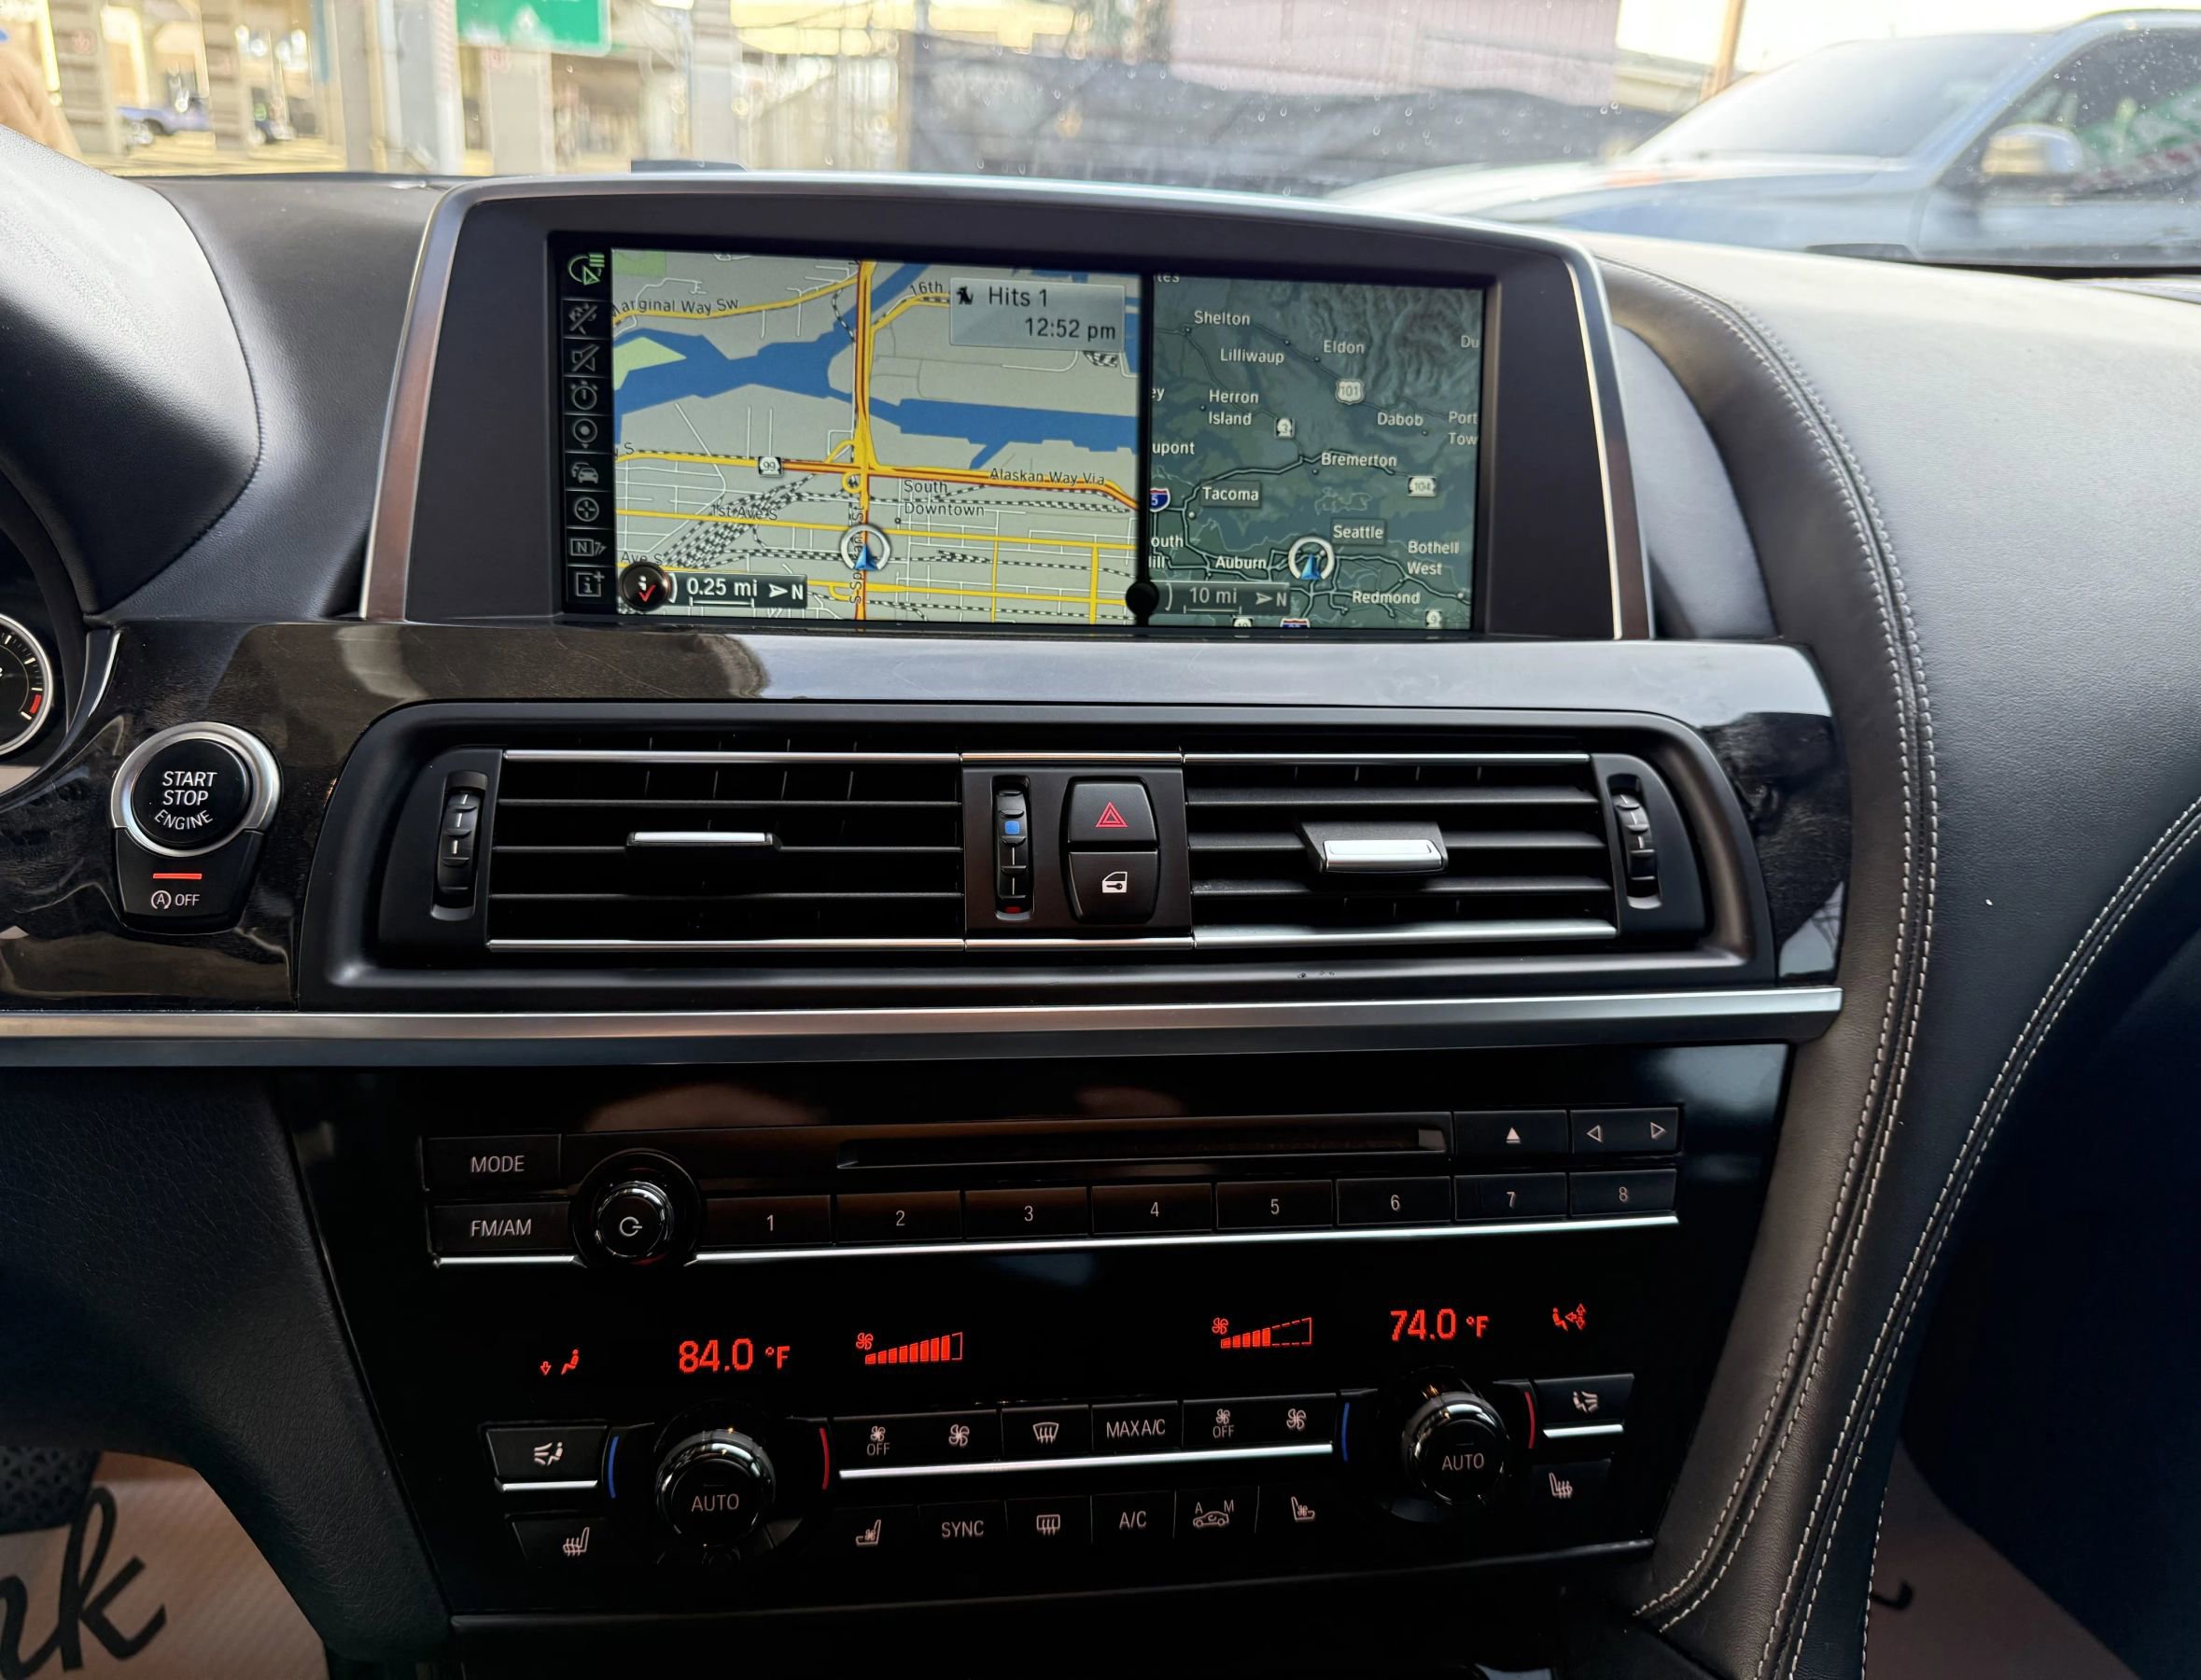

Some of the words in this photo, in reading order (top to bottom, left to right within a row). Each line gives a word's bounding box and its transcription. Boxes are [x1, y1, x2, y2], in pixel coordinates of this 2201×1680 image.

[910, 280, 944, 297] 16th
[988, 287, 1031, 307] Hits
[1039, 288, 1048, 308] 1
[681, 300, 711, 315] Way
[1194, 310, 1251, 326] Shelton
[1025, 317, 1081, 339] 12:52
[1087, 325, 1117, 342] pm
[1324, 340, 1365, 355] Eldon
[1460, 334, 1480, 349] Du
[1220, 348, 1284, 366] Lilliwaup
[1209, 389, 1259, 404] Herron
[1340, 385, 1359, 398] 101
[1208, 411, 1252, 426] Island
[1378, 412, 1424, 427] Dabob
[1448, 411, 1479, 425] Port
[1448, 431, 1479, 446] Tow
[624, 441, 636, 455] S
[1152, 441, 1196, 456] upont
[763, 461, 777, 472] 99
[1321, 452, 1398, 468] Bremerton
[989, 468, 1044, 483] Alaskan
[1049, 470, 1078, 486] Way
[1082, 472, 1105, 486] Via
[904, 479, 948, 494] South
[1202, 486, 1259, 502] Tacoma
[1150, 494, 1159, 507] 5
[712, 505, 733, 518] 1st
[736, 506, 764, 520] Ave
[768, 508, 778, 521] S
[904, 501, 986, 517] Downtown
[1333, 525, 1384, 540] Seattle
[1151, 535, 1185, 549] outh
[1408, 540, 1460, 555] Bothell
[620, 551, 648, 564] Ave
[1215, 555, 1268, 570] Auburn
[1407, 562, 1443, 577] West
[685, 576, 727, 596] 0.25
[734, 578, 759, 597] mi
[791, 583, 805, 600] N
[1189, 586, 1211, 604] 10
[1215, 587, 1238, 605] mi
[1275, 591, 1287, 608] N
[1352, 590, 1421, 606] Redmond
[161, 770, 218, 788] START
[161, 789, 210, 806] STOP
[153, 807, 214, 831] ENGINE
[156, 892, 166, 906] A
[174, 892, 201, 906] OFF
[470, 1154, 525, 1173] MODE
[1507, 1191, 1516, 1207] 7
[1619, 1186, 1629, 1202] 8
[1150, 1201, 1160, 1217] 4
[1270, 1198, 1280, 1215] 5
[1390, 1194, 1400, 1211] 6
[894, 1210, 905, 1226] 2
[1023, 1205, 1033, 1223] 3
[470, 1217, 533, 1238] FM/AM
[765, 1214, 774, 1231] 1
[1390, 1308, 1456, 1342] 74.0
[1465, 1315, 1490, 1338] °F
[679, 1337, 754, 1374] 84.0
[764, 1345, 791, 1370] °F
[1106, 1420, 1141, 1438] MAX
[1141, 1418, 1166, 1436] A/C
[1213, 1424, 1235, 1440] OFF
[866, 1441, 890, 1457] OFF
[1441, 1451, 1485, 1471] AUTO
[691, 1492, 740, 1513] AUTO
[1194, 1503, 1203, 1516] A
[1224, 1499, 1235, 1513] M
[1119, 1509, 1147, 1530] A/C
[941, 1519, 985, 1538] SYNC
